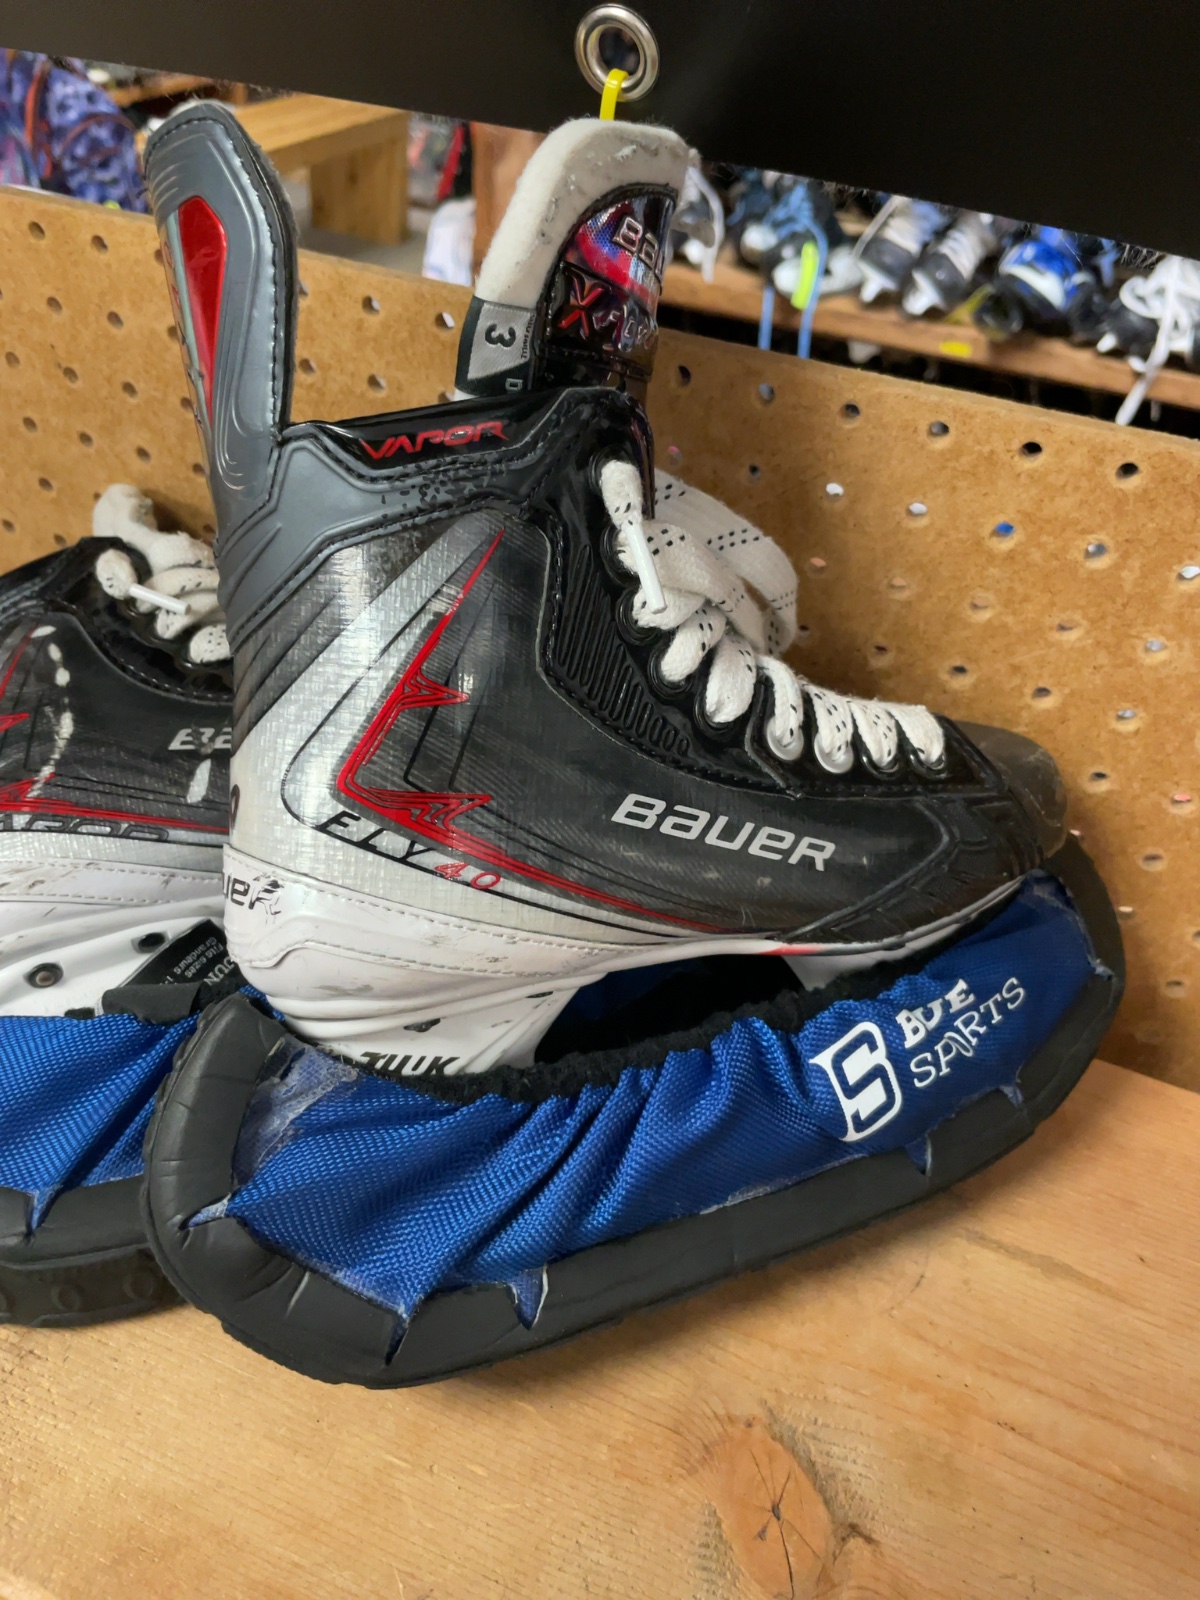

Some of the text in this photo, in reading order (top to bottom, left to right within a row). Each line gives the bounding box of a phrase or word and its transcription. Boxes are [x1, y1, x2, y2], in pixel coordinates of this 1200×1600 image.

[485, 323, 516, 348] 3
[359, 420, 509, 460] VAPOR
[361, 1051, 460, 1075] TUUK
